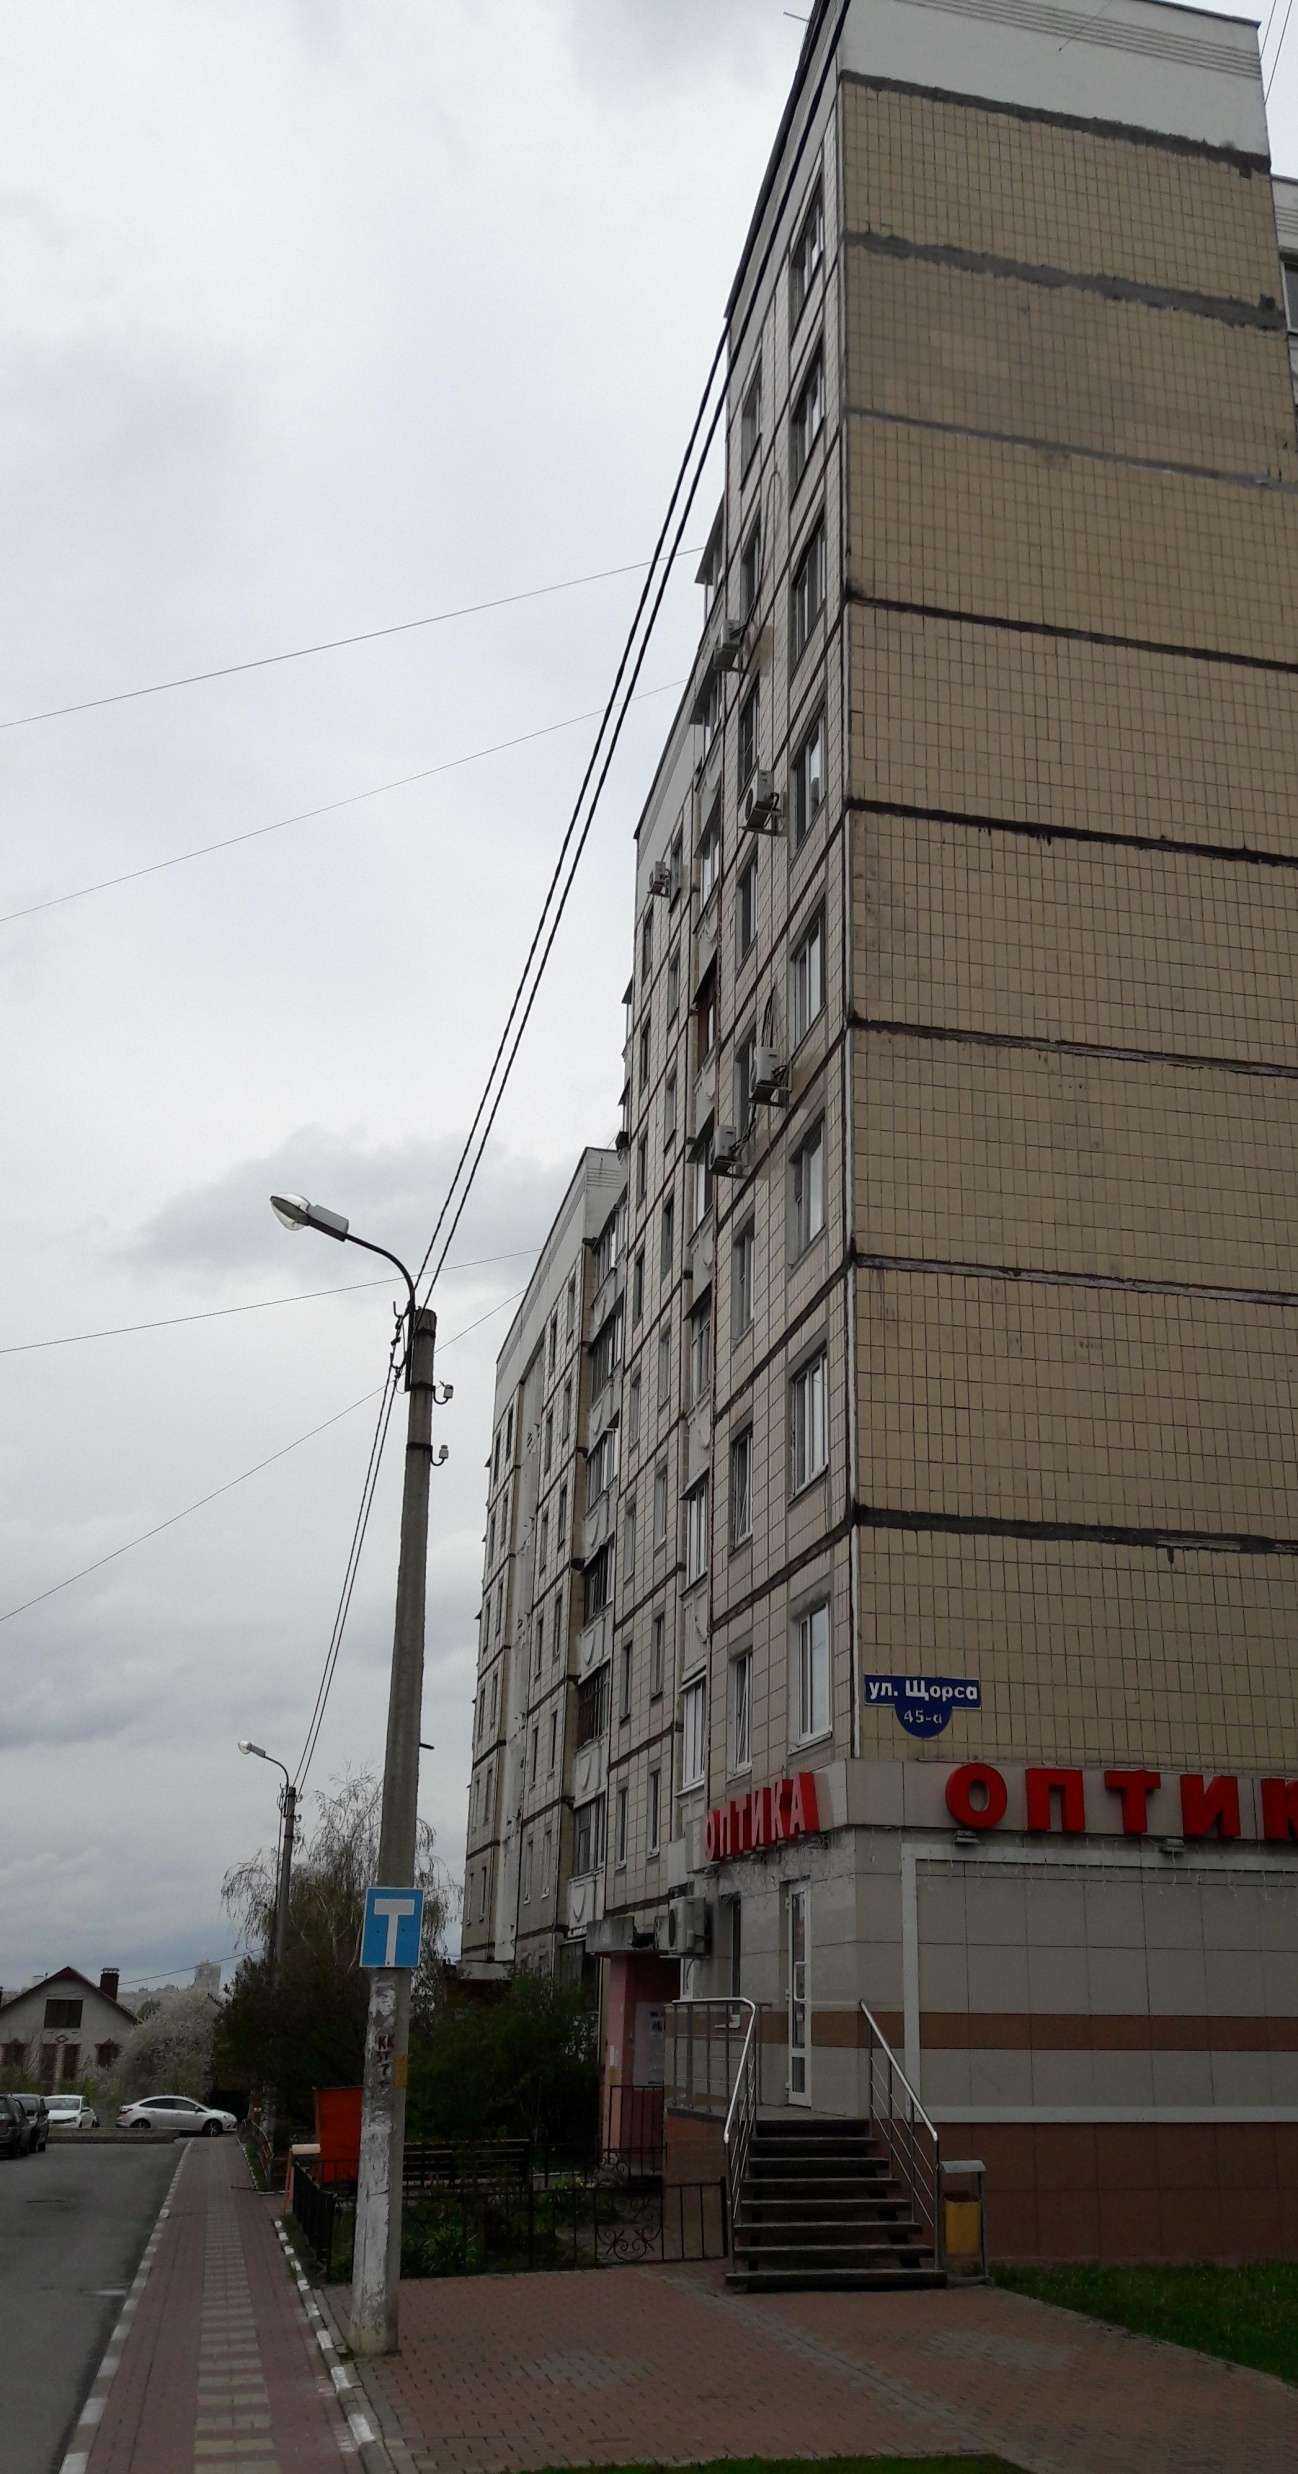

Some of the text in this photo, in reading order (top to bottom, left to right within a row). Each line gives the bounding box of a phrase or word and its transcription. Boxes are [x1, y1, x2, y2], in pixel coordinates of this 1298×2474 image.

[869, 1679, 978, 1702] ул. Щорса
[704, 1771, 820, 1862] ОПТИКА
